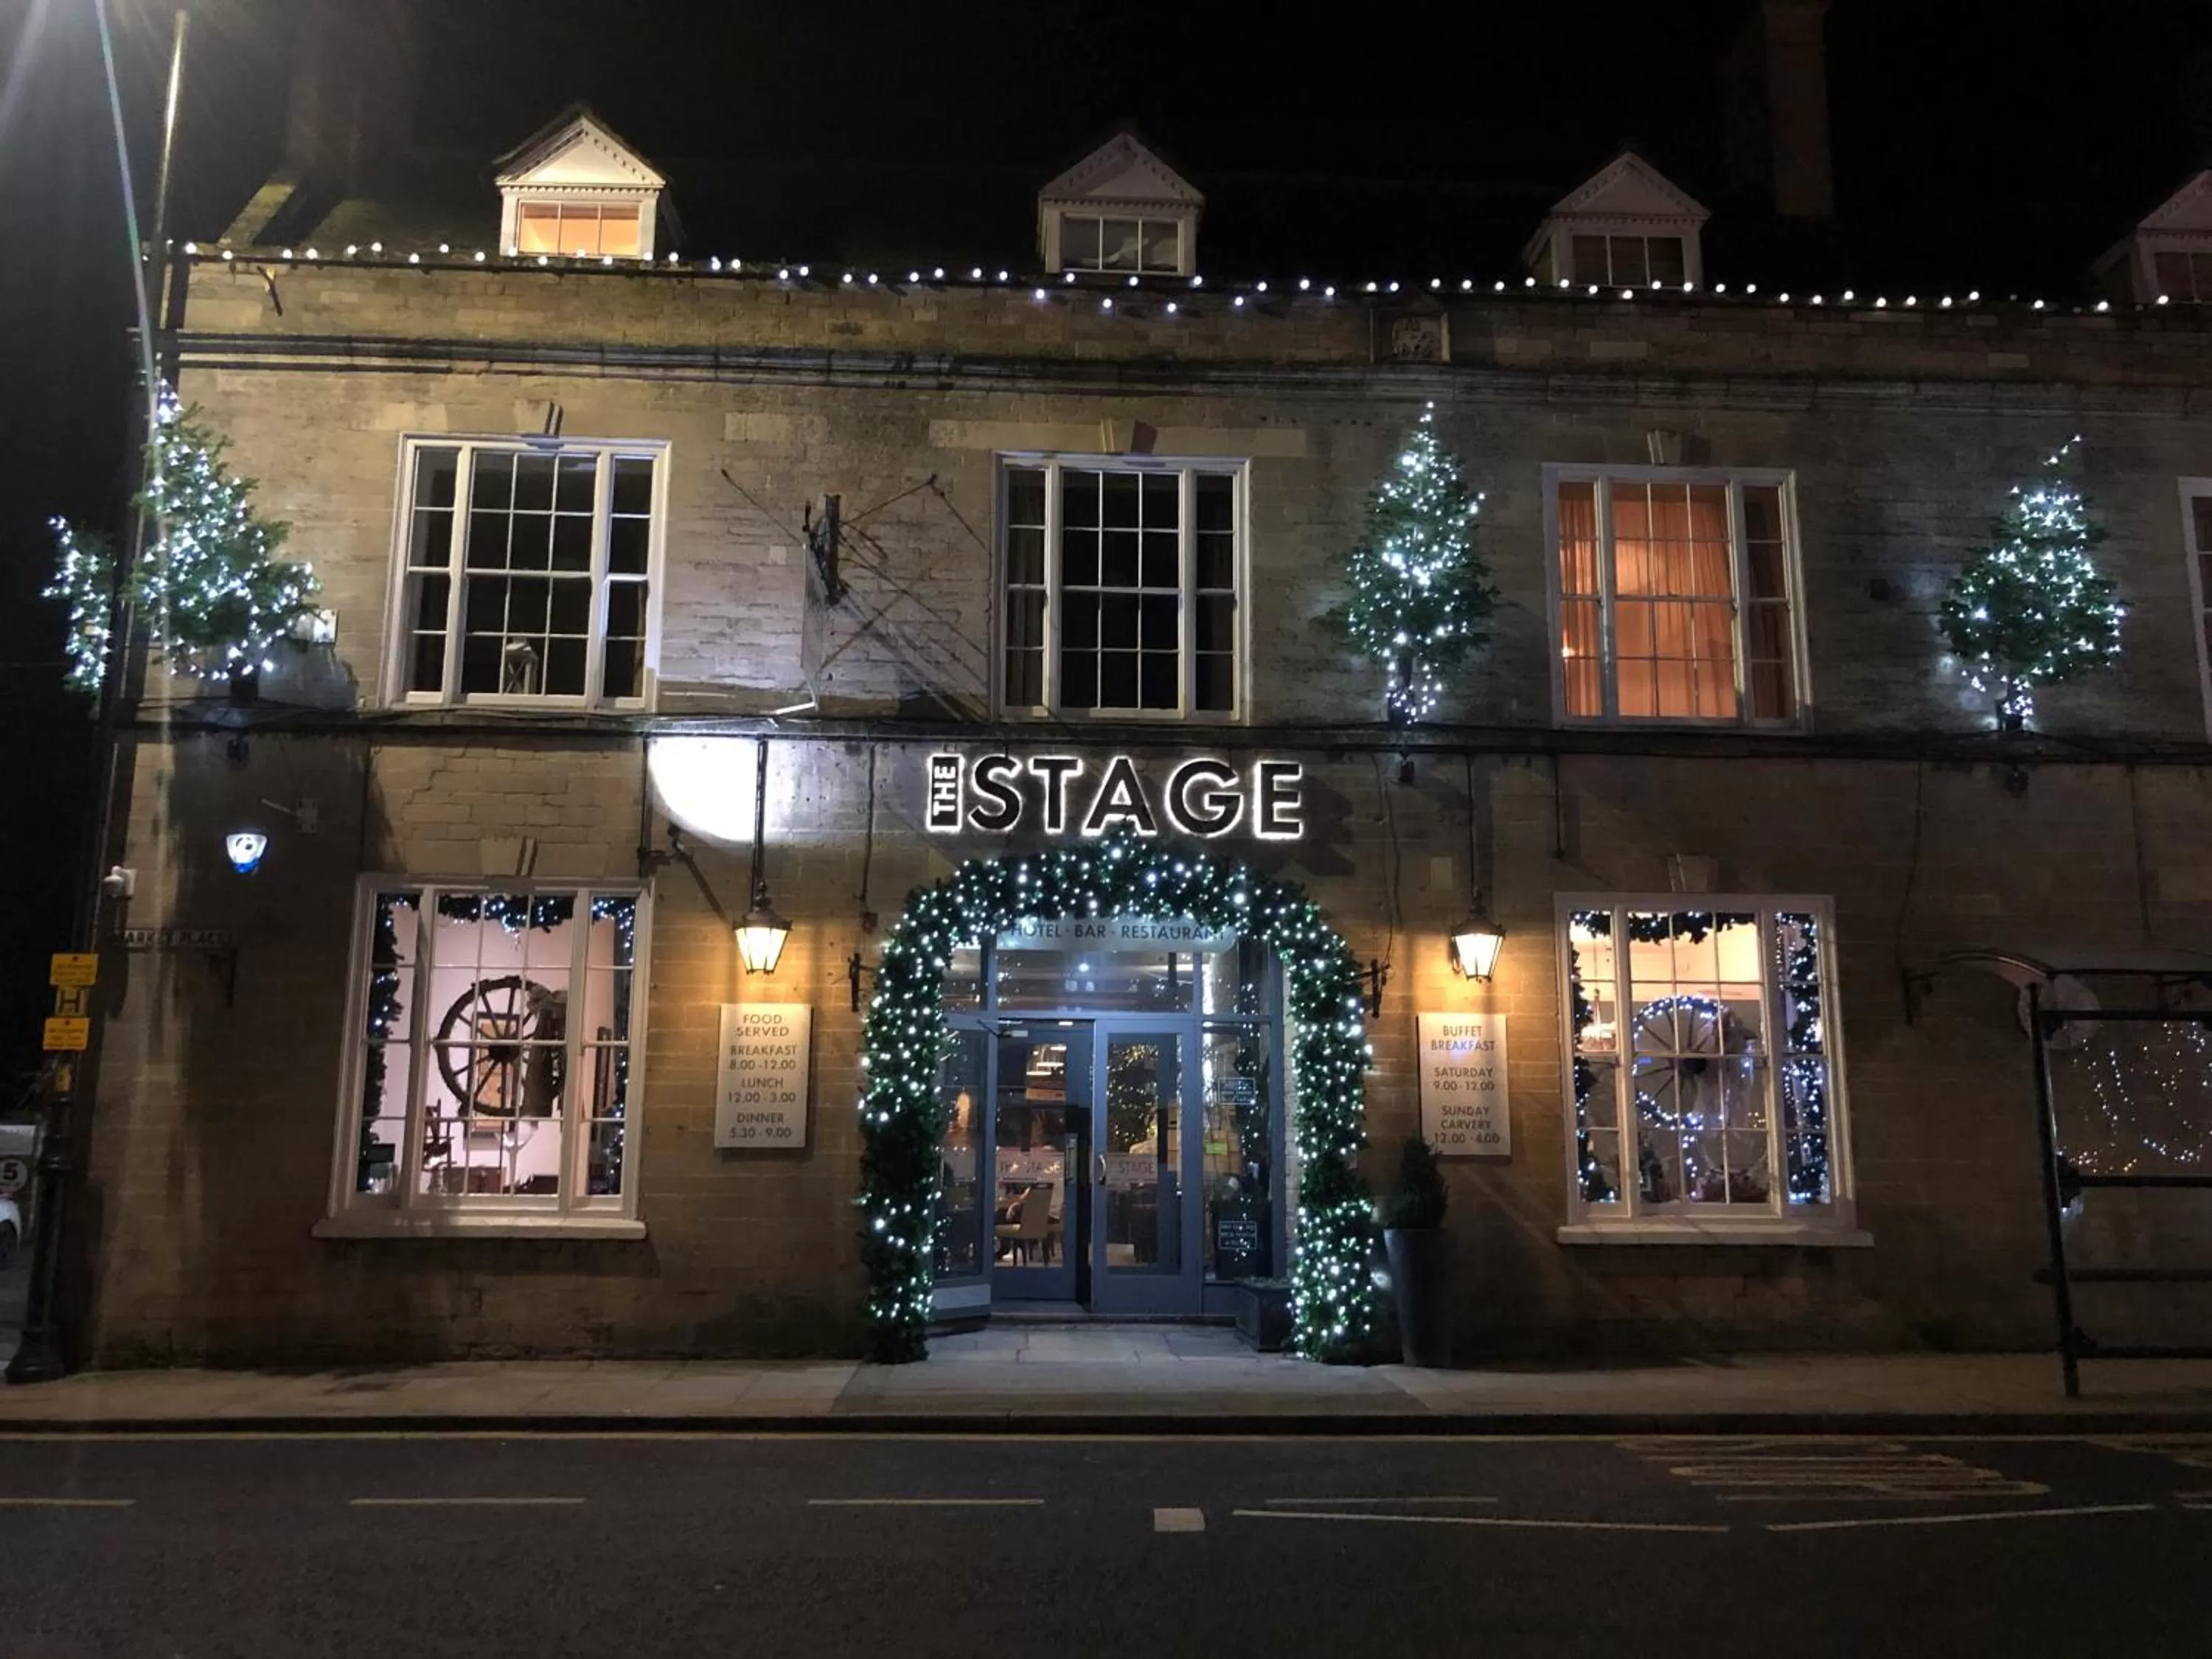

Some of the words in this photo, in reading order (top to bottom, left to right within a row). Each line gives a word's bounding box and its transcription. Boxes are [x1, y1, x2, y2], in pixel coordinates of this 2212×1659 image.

[934, 765, 956, 816] THE
[968, 756, 1302, 838] STAGE
[1012, 923, 1061, 938] HOTEL
[1074, 924, 1106, 939] BAR
[742, 1014, 782, 1024] FOOD
[736, 1026, 790, 1037] SERVED
[1443, 1026, 1482, 1037] BUFFET
[731, 1045, 797, 1056] BREAKFAST
[1431, 1040, 1495, 1051] BREAKFAST
[730, 1060, 756, 1070] 8.00
[1434, 1067, 1493, 1078] SATURDAY
[741, 1077, 784, 1088] LUNCH
[1433, 1081, 1457, 1091] 9.00
[1466, 1081, 1495, 1091] 12.00
[728, 1091, 760, 1103] 12.00
[1441, 1105, 1490, 1116] SUNDAY
[737, 1112, 785, 1124] DINNER
[1441, 1119, 1492, 1130] CARVERY
[1434, 1132, 1466, 1144] 12.00
